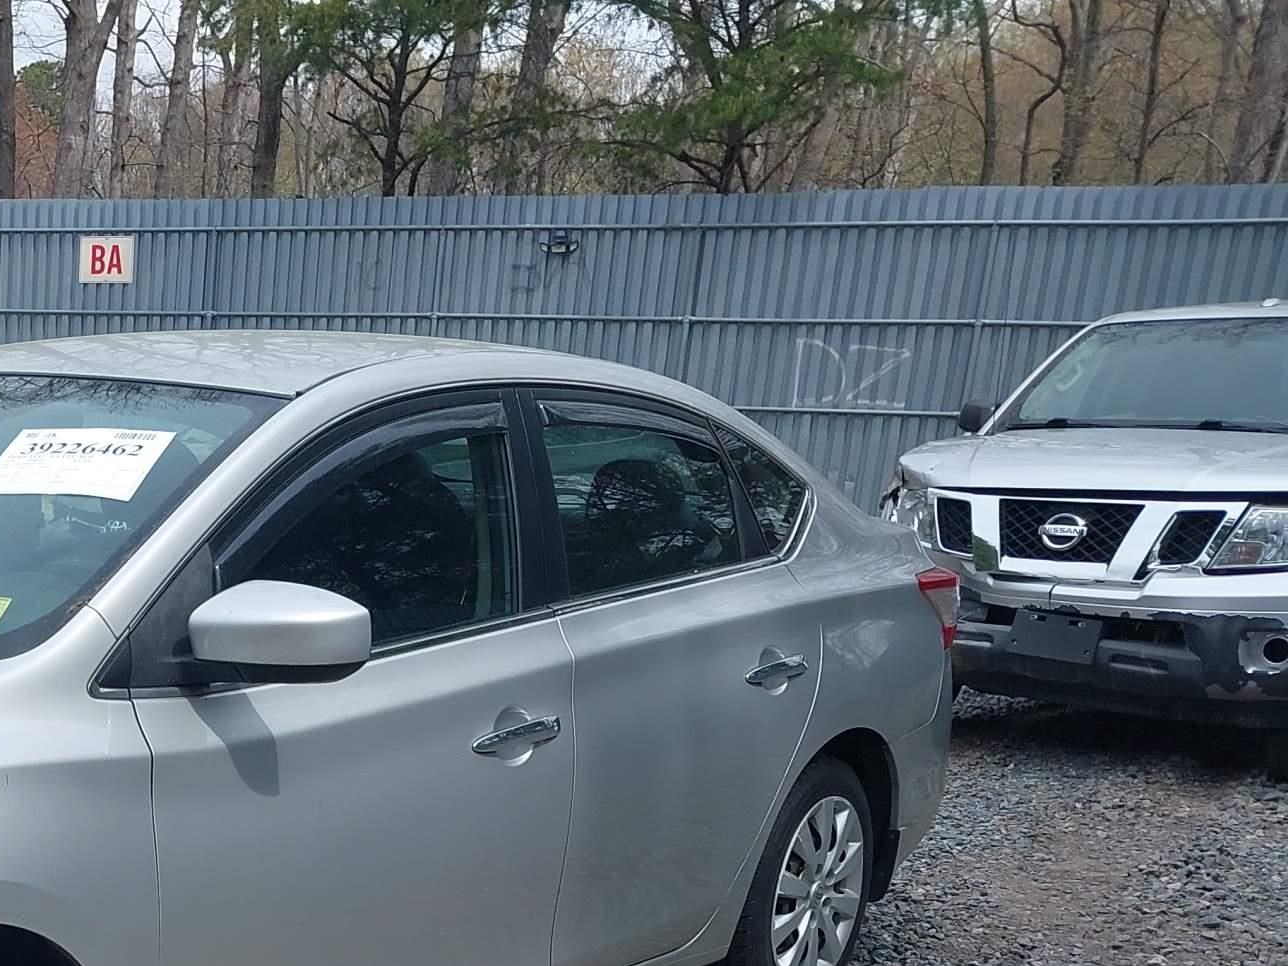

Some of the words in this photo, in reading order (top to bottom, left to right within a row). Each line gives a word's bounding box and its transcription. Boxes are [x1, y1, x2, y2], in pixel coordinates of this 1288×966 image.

[90, 244, 122, 275] BA
[792, 338, 911, 409] DZ
[20, 441, 144, 457] 39226462
[1041, 526, 1083, 536] NISSAN
